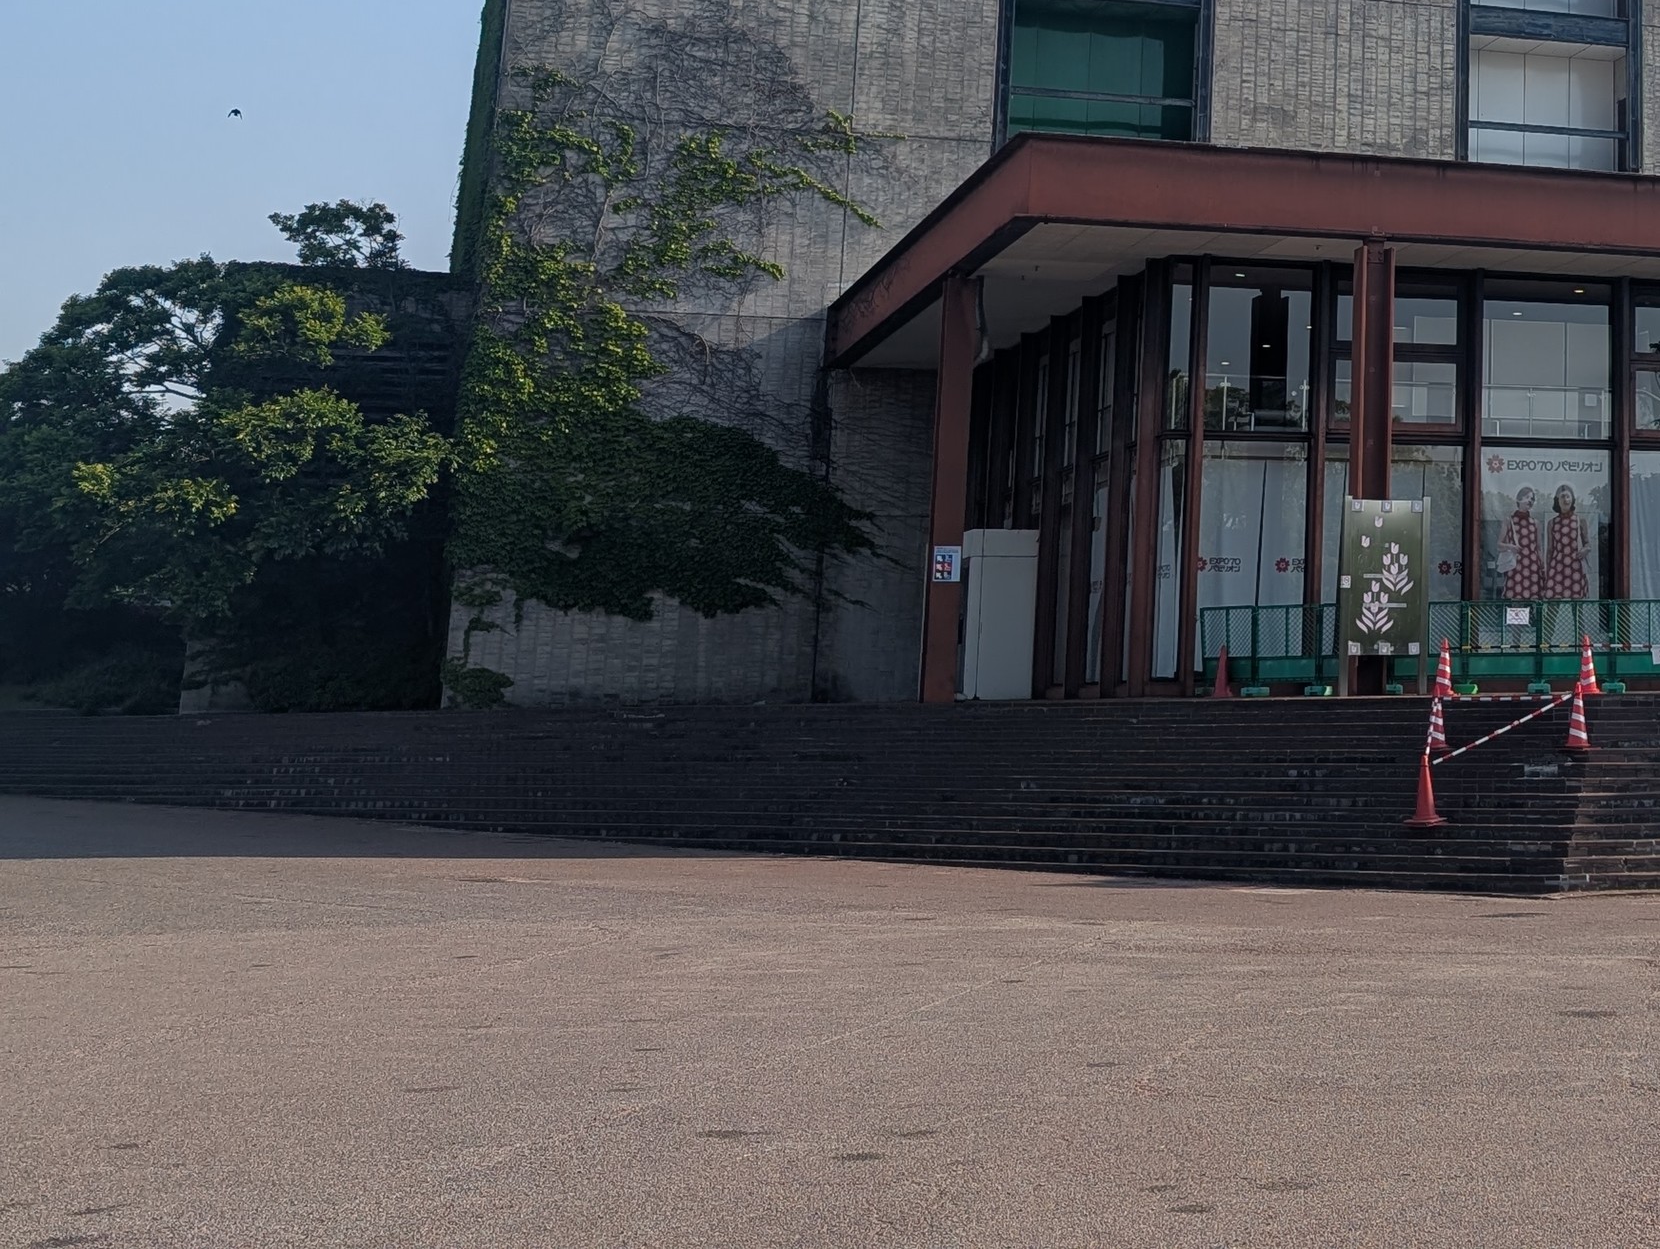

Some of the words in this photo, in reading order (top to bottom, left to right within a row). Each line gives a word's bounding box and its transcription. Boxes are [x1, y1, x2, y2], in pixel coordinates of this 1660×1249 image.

[1555, 460, 1602, 472] パビリオン
